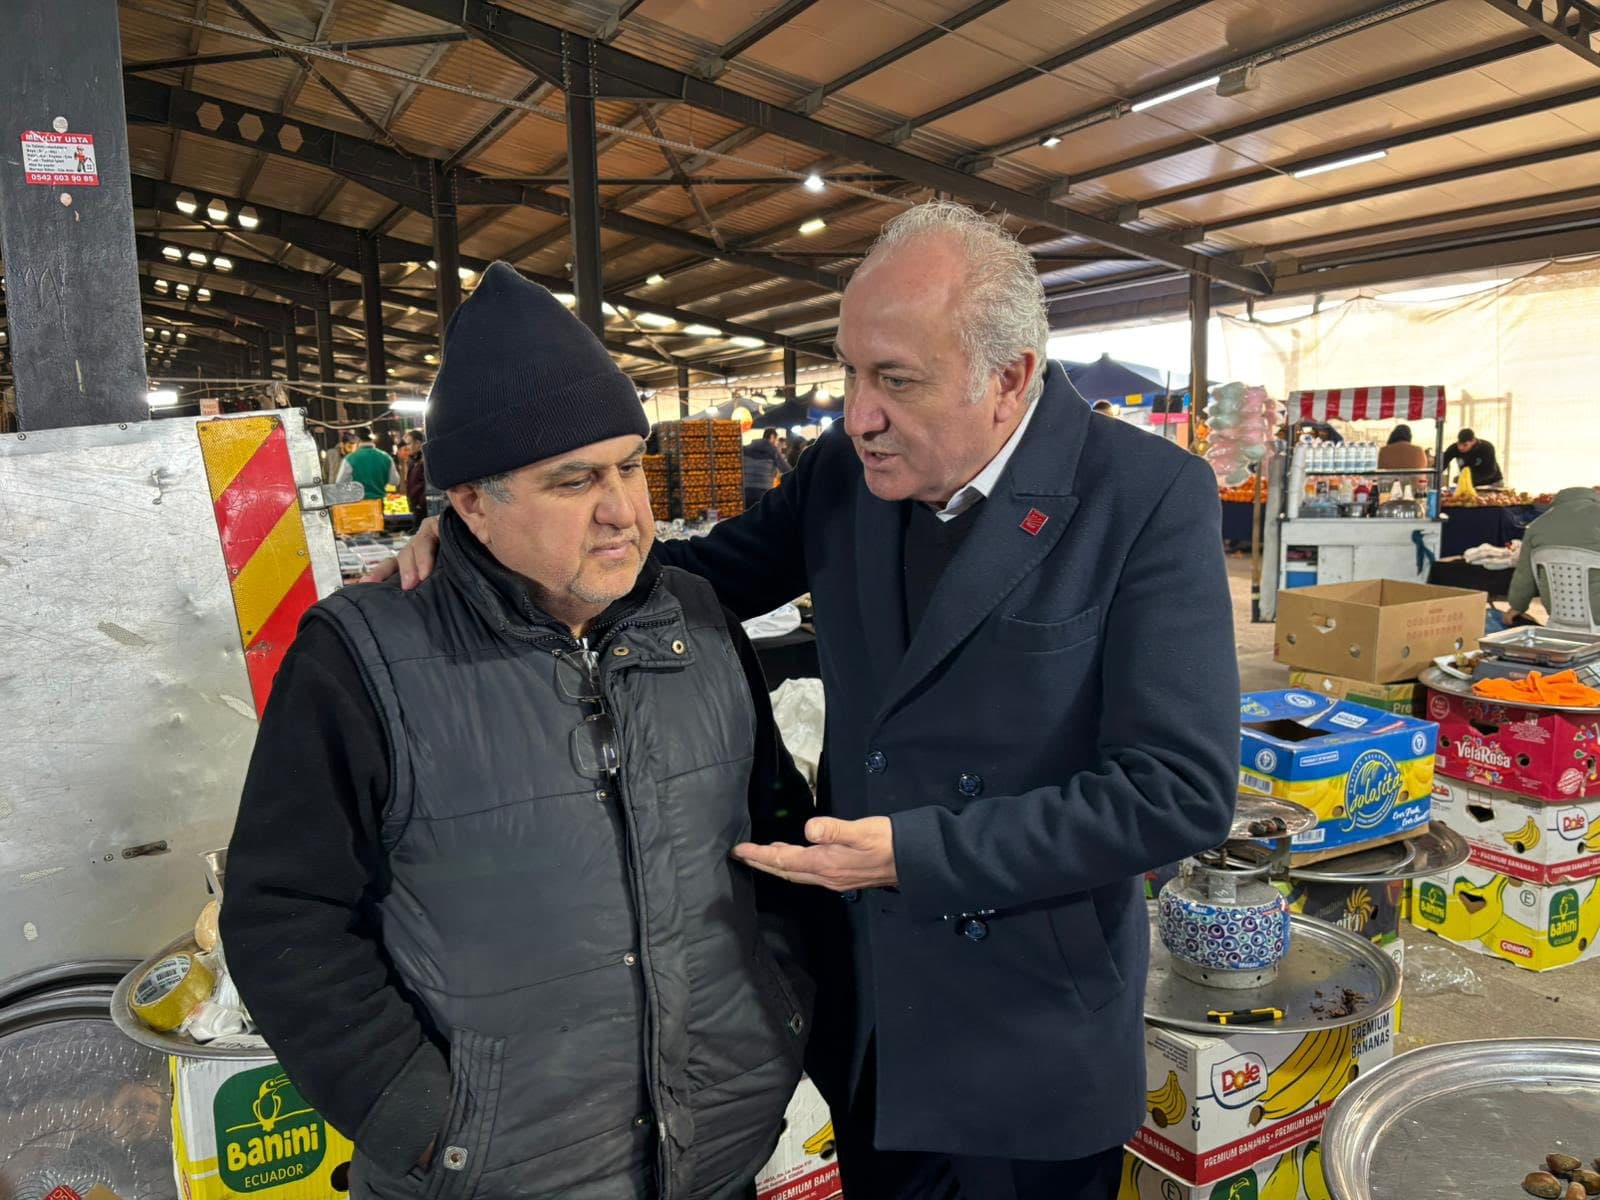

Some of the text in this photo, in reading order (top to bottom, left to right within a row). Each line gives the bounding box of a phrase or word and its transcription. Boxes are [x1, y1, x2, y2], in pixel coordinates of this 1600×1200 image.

[65, 135, 89, 143] USTA
[1454, 740, 1511, 769] VelaRosa
[1563, 813, 1585, 831] Dole
[1508, 859, 1536, 873] BANANAS
[1352, 1012, 1390, 1042] PREMIUM
[1352, 1029, 1390, 1059] BANANAS
[1222, 1062, 1260, 1092] Dole
[227, 1123, 319, 1172] Banini
[1143, 1133, 1181, 1162] BANANAS
[1204, 1147, 1237, 1168] PREMIUM
[1239, 1133, 1270, 1154] BANANAS
[1275, 1118, 1305, 1139] PREMIUM
[1306, 1109, 1327, 1126] BANAN
[245, 1163, 304, 1189] ECUADOR
